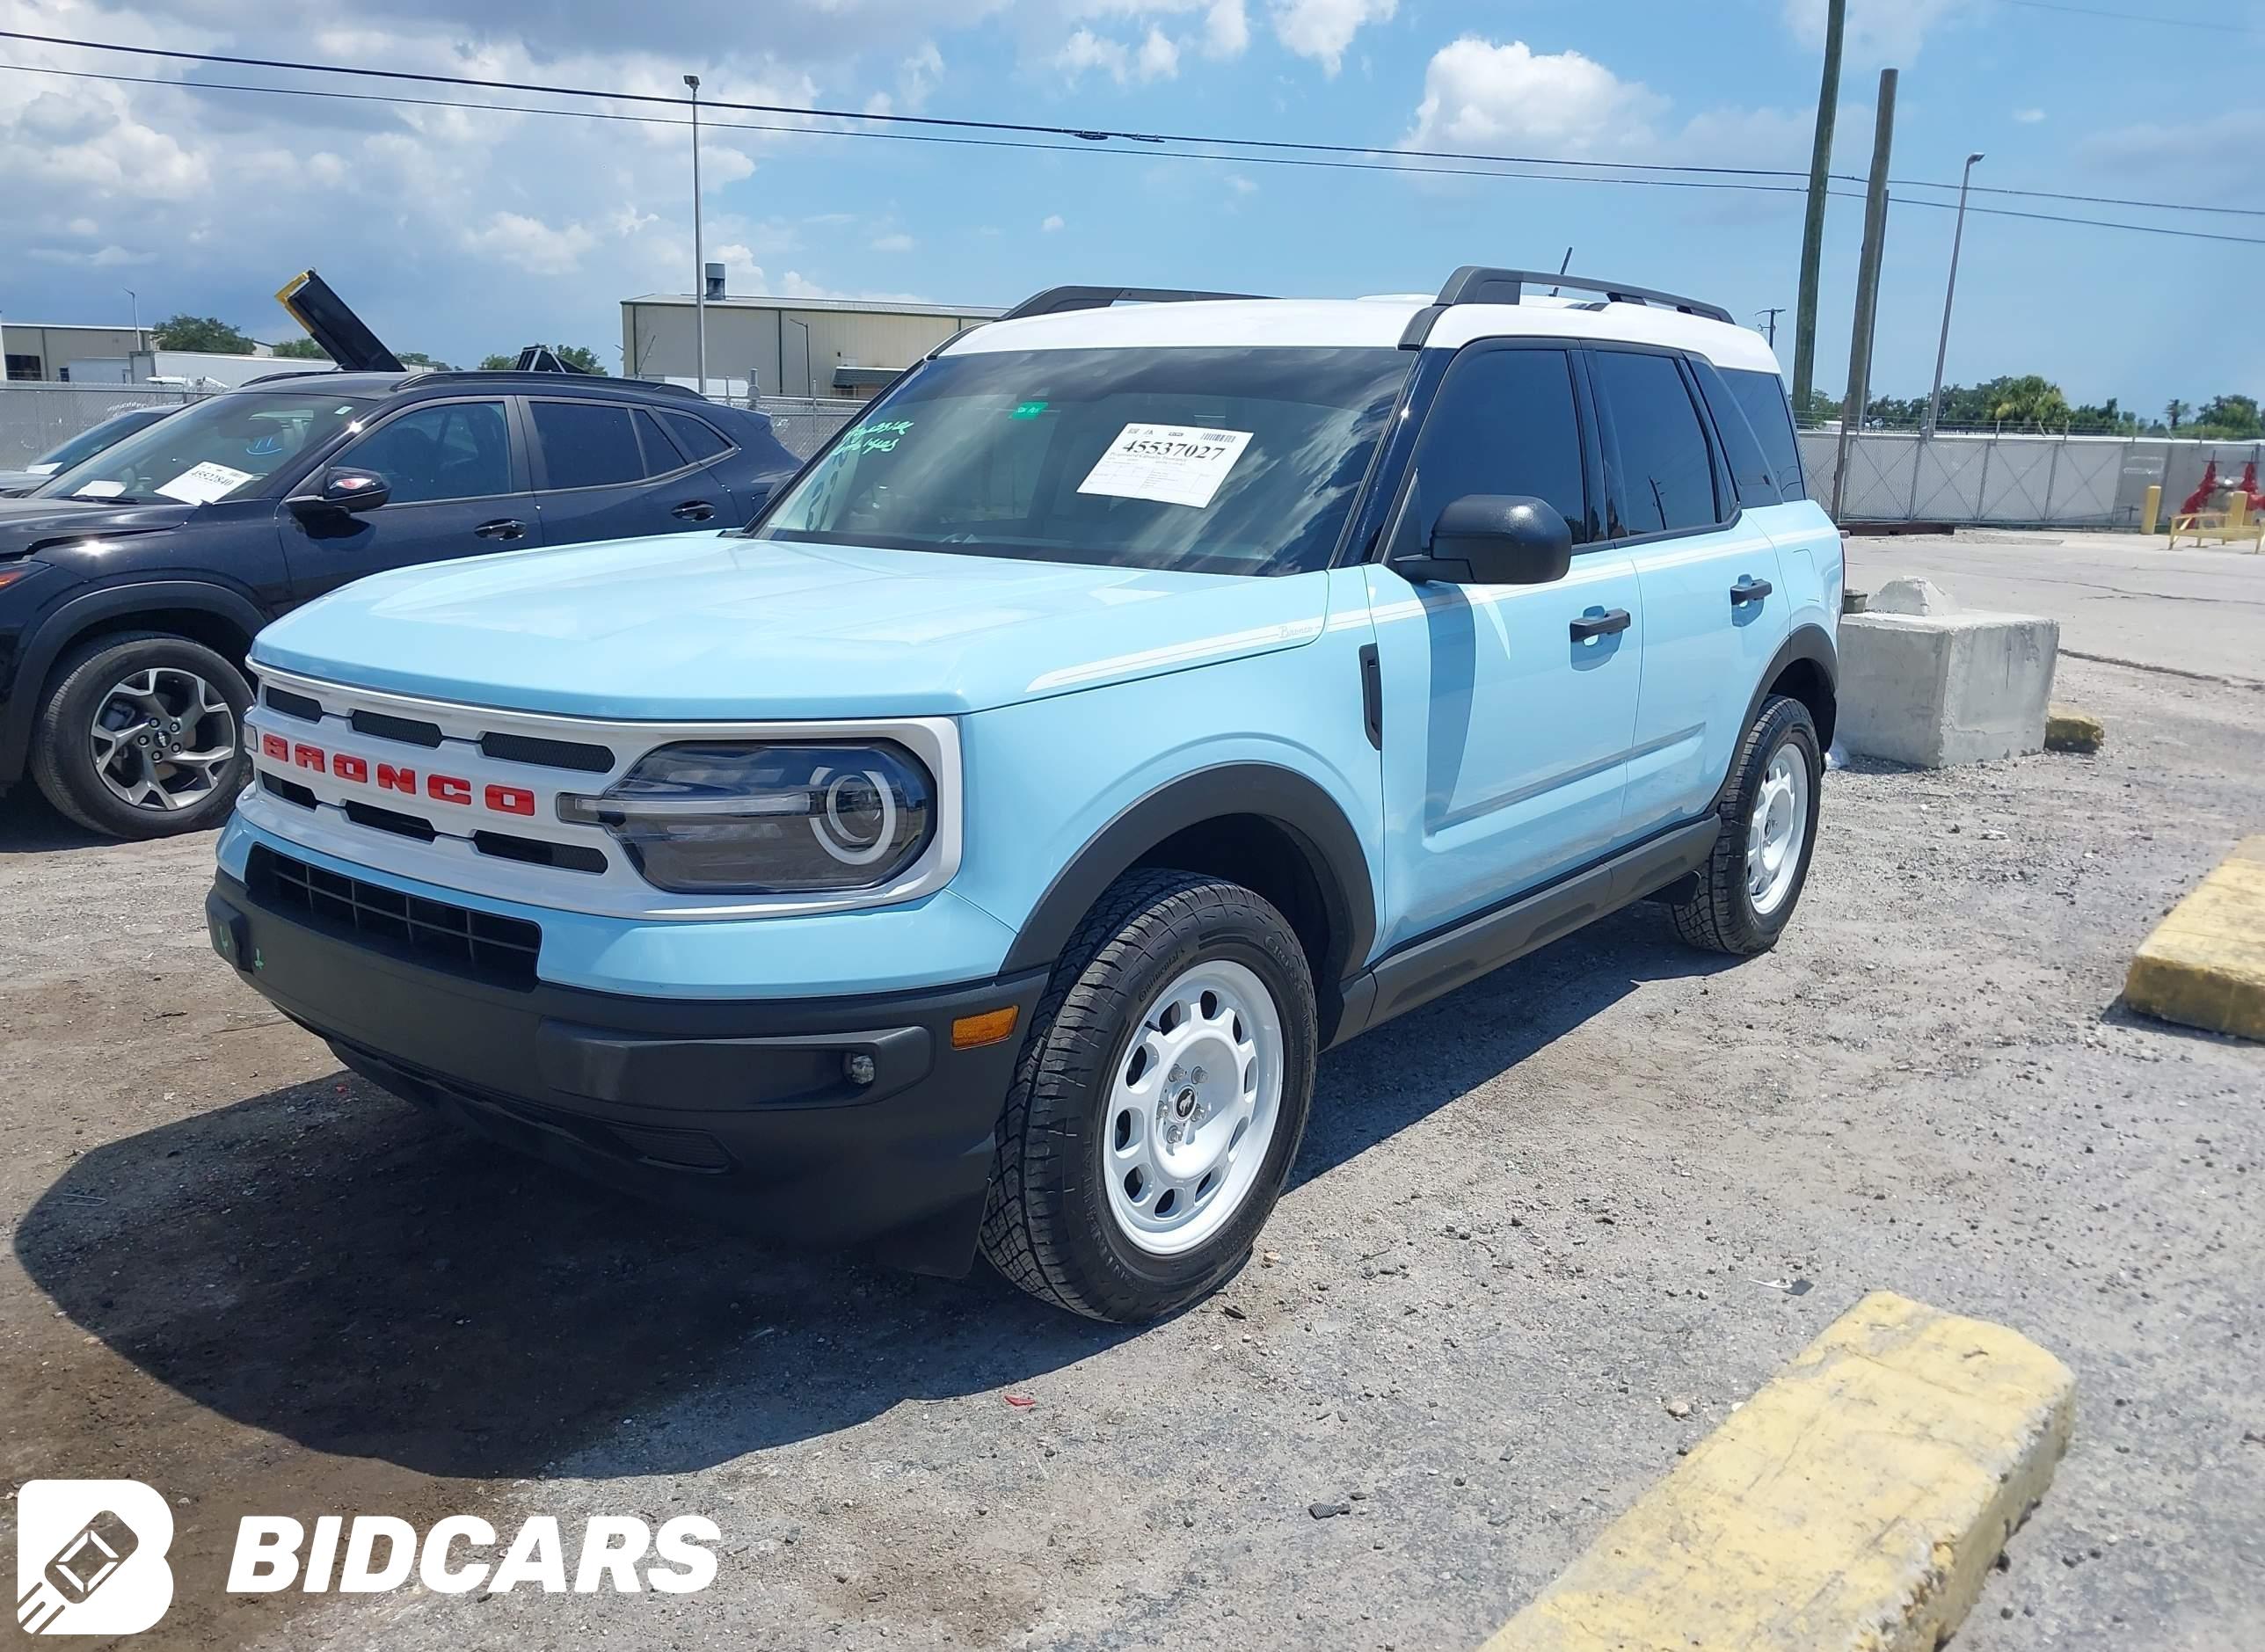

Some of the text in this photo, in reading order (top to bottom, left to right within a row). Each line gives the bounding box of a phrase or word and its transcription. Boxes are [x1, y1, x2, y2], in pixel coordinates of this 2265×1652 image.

[1122, 440, 1226, 462] 45537027
[191, 470, 235, 486] 45522840
[263, 733, 535, 817] BRONCO
